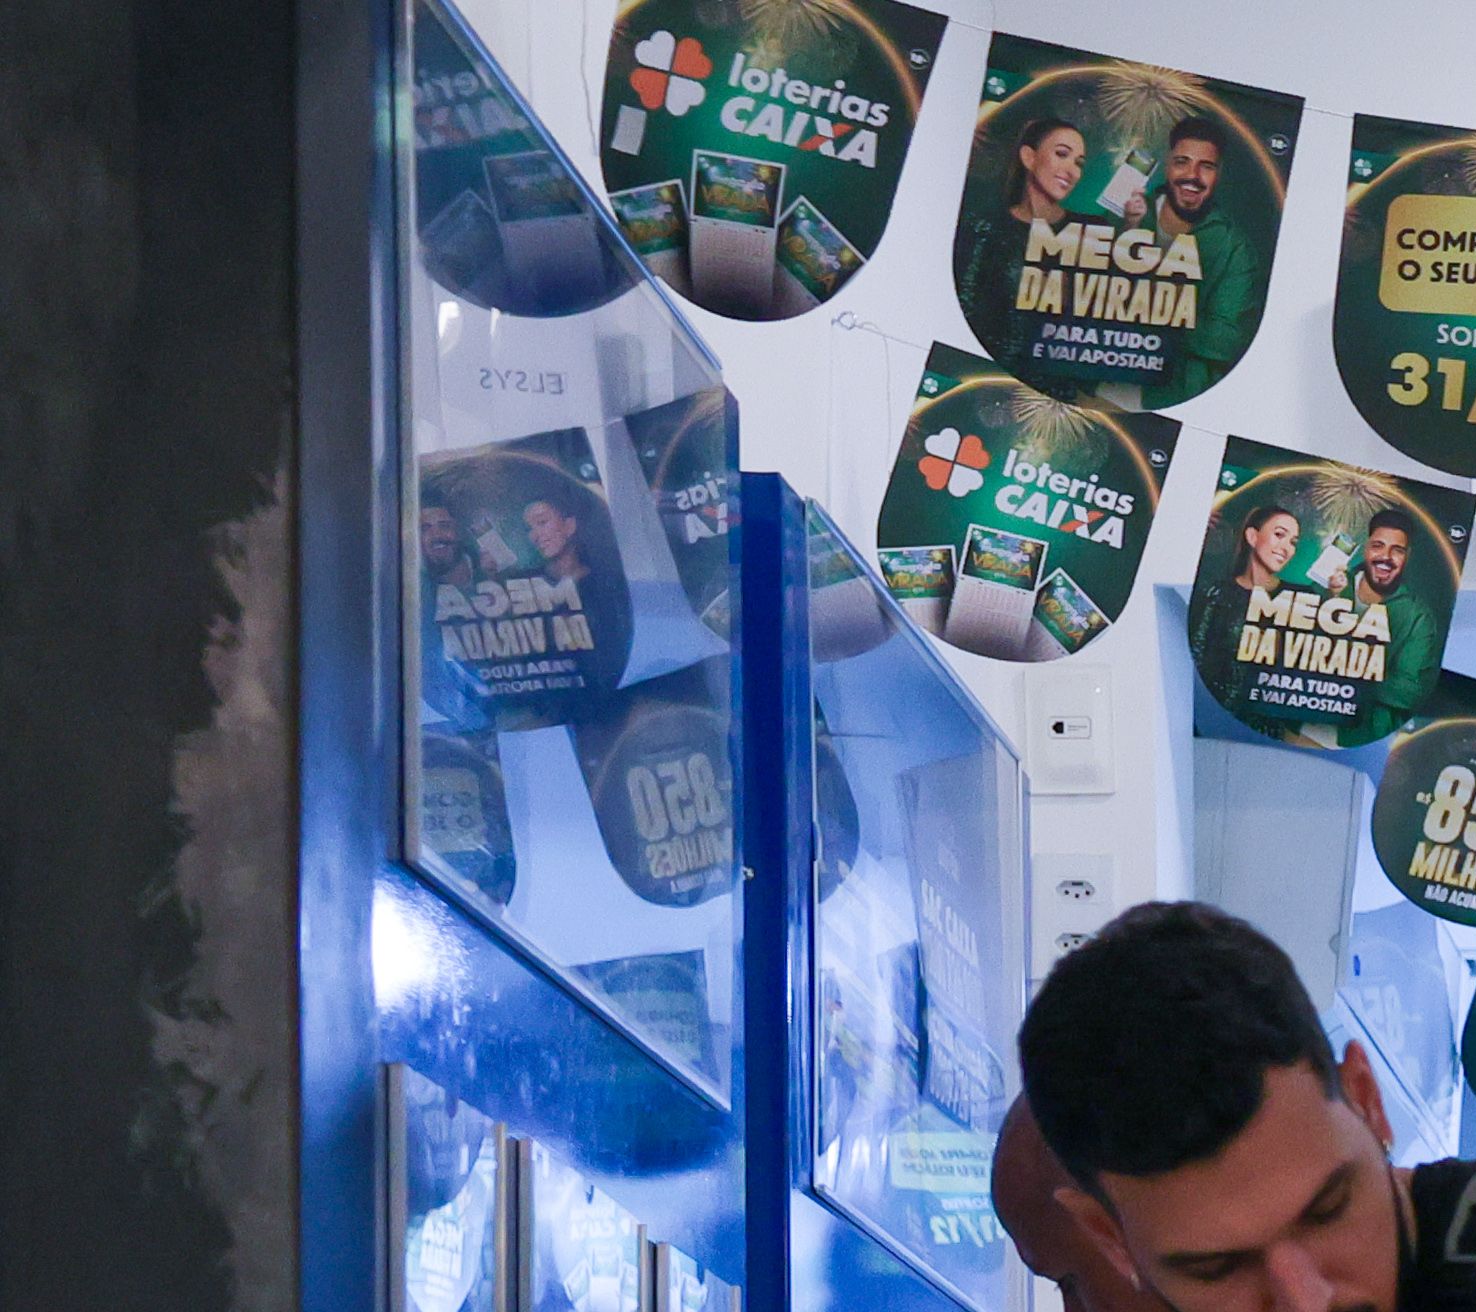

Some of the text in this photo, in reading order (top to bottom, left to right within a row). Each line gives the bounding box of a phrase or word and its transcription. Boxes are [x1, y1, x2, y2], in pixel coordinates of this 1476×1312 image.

[728, 52, 889, 128] loterias
[720, 98, 879, 169] CAIXA
[1024, 218, 1202, 280] MEGA
[1397, 260, 1420, 282] O
[1015, 275, 1196, 329] DA VIRADA
[1041, 322, 1161, 350] PARA TUDO
[1080, 348, 1164, 372] APOSTAR!
[1002, 449, 1134, 514] loterias
[1245, 586, 1391, 642] MEGA
[1287, 694, 1356, 716] APOSTAR!
